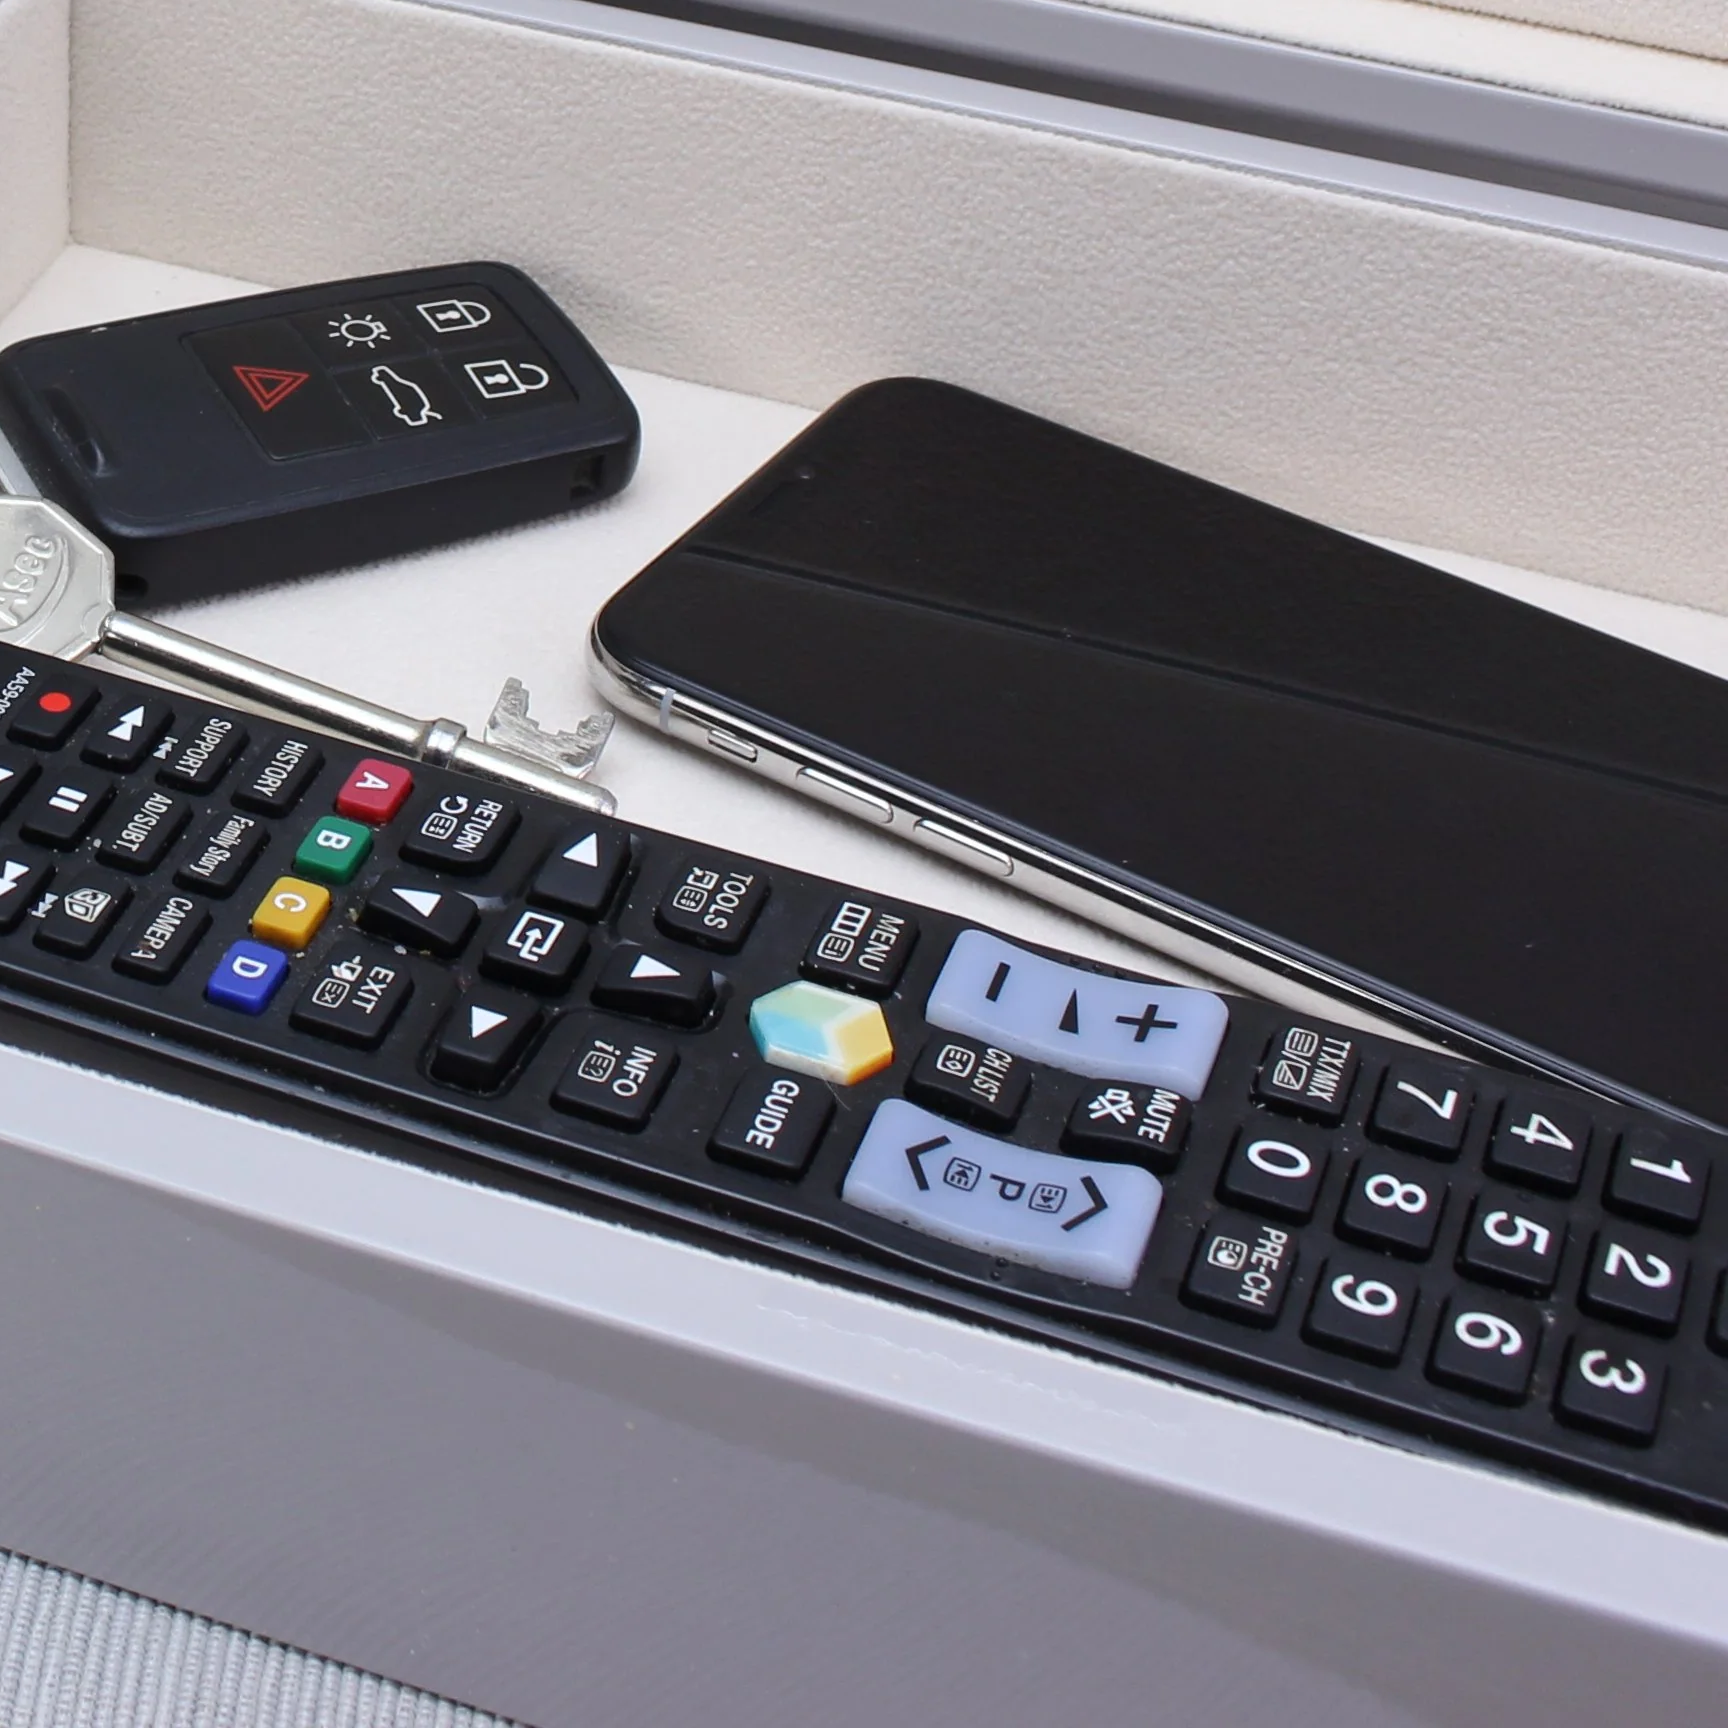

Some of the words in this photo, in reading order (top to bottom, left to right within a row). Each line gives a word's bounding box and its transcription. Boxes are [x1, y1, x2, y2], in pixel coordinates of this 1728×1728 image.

[175, 718, 232, 777] SUPPORT
[253, 739, 308, 798] HISTORY
[355, 771, 389, 790] A
[112, 792, 173, 852] AD/SUBT.
[209, 815, 255, 849] Family
[316, 829, 352, 849] B
[452, 799, 503, 853] RETURN
[189, 846, 231, 877] Story
[273, 892, 308, 913] C
[704, 871, 754, 929] TOOLS
[858, 913, 905, 971] MENU
[232, 955, 268, 978] D
[352, 966, 395, 1014] EXIT
[612, 1045, 657, 1097] INFO
[1307, 1036, 1351, 1102] TTX/MIX
[745, 1079, 800, 1149] GUIDE
[1138, 1089, 1180, 1143] MUTE
[1397, 1081, 1458, 1120] 7
[1510, 1113, 1574, 1151] 4
[1247, 1140, 1311, 1178] 0
[1630, 1157, 1692, 1184] 1
[990, 1173, 1027, 1201] P
[1364, 1174, 1427, 1213] 8
[1483, 1211, 1550, 1256] 5
[1238, 1225, 1288, 1306] PRE-CH
[1604, 1243, 1671, 1288] 2
[1331, 1274, 1398, 1316] 9
[1454, 1312, 1522, 1356] 6
[1579, 1350, 1646, 1394] 3
